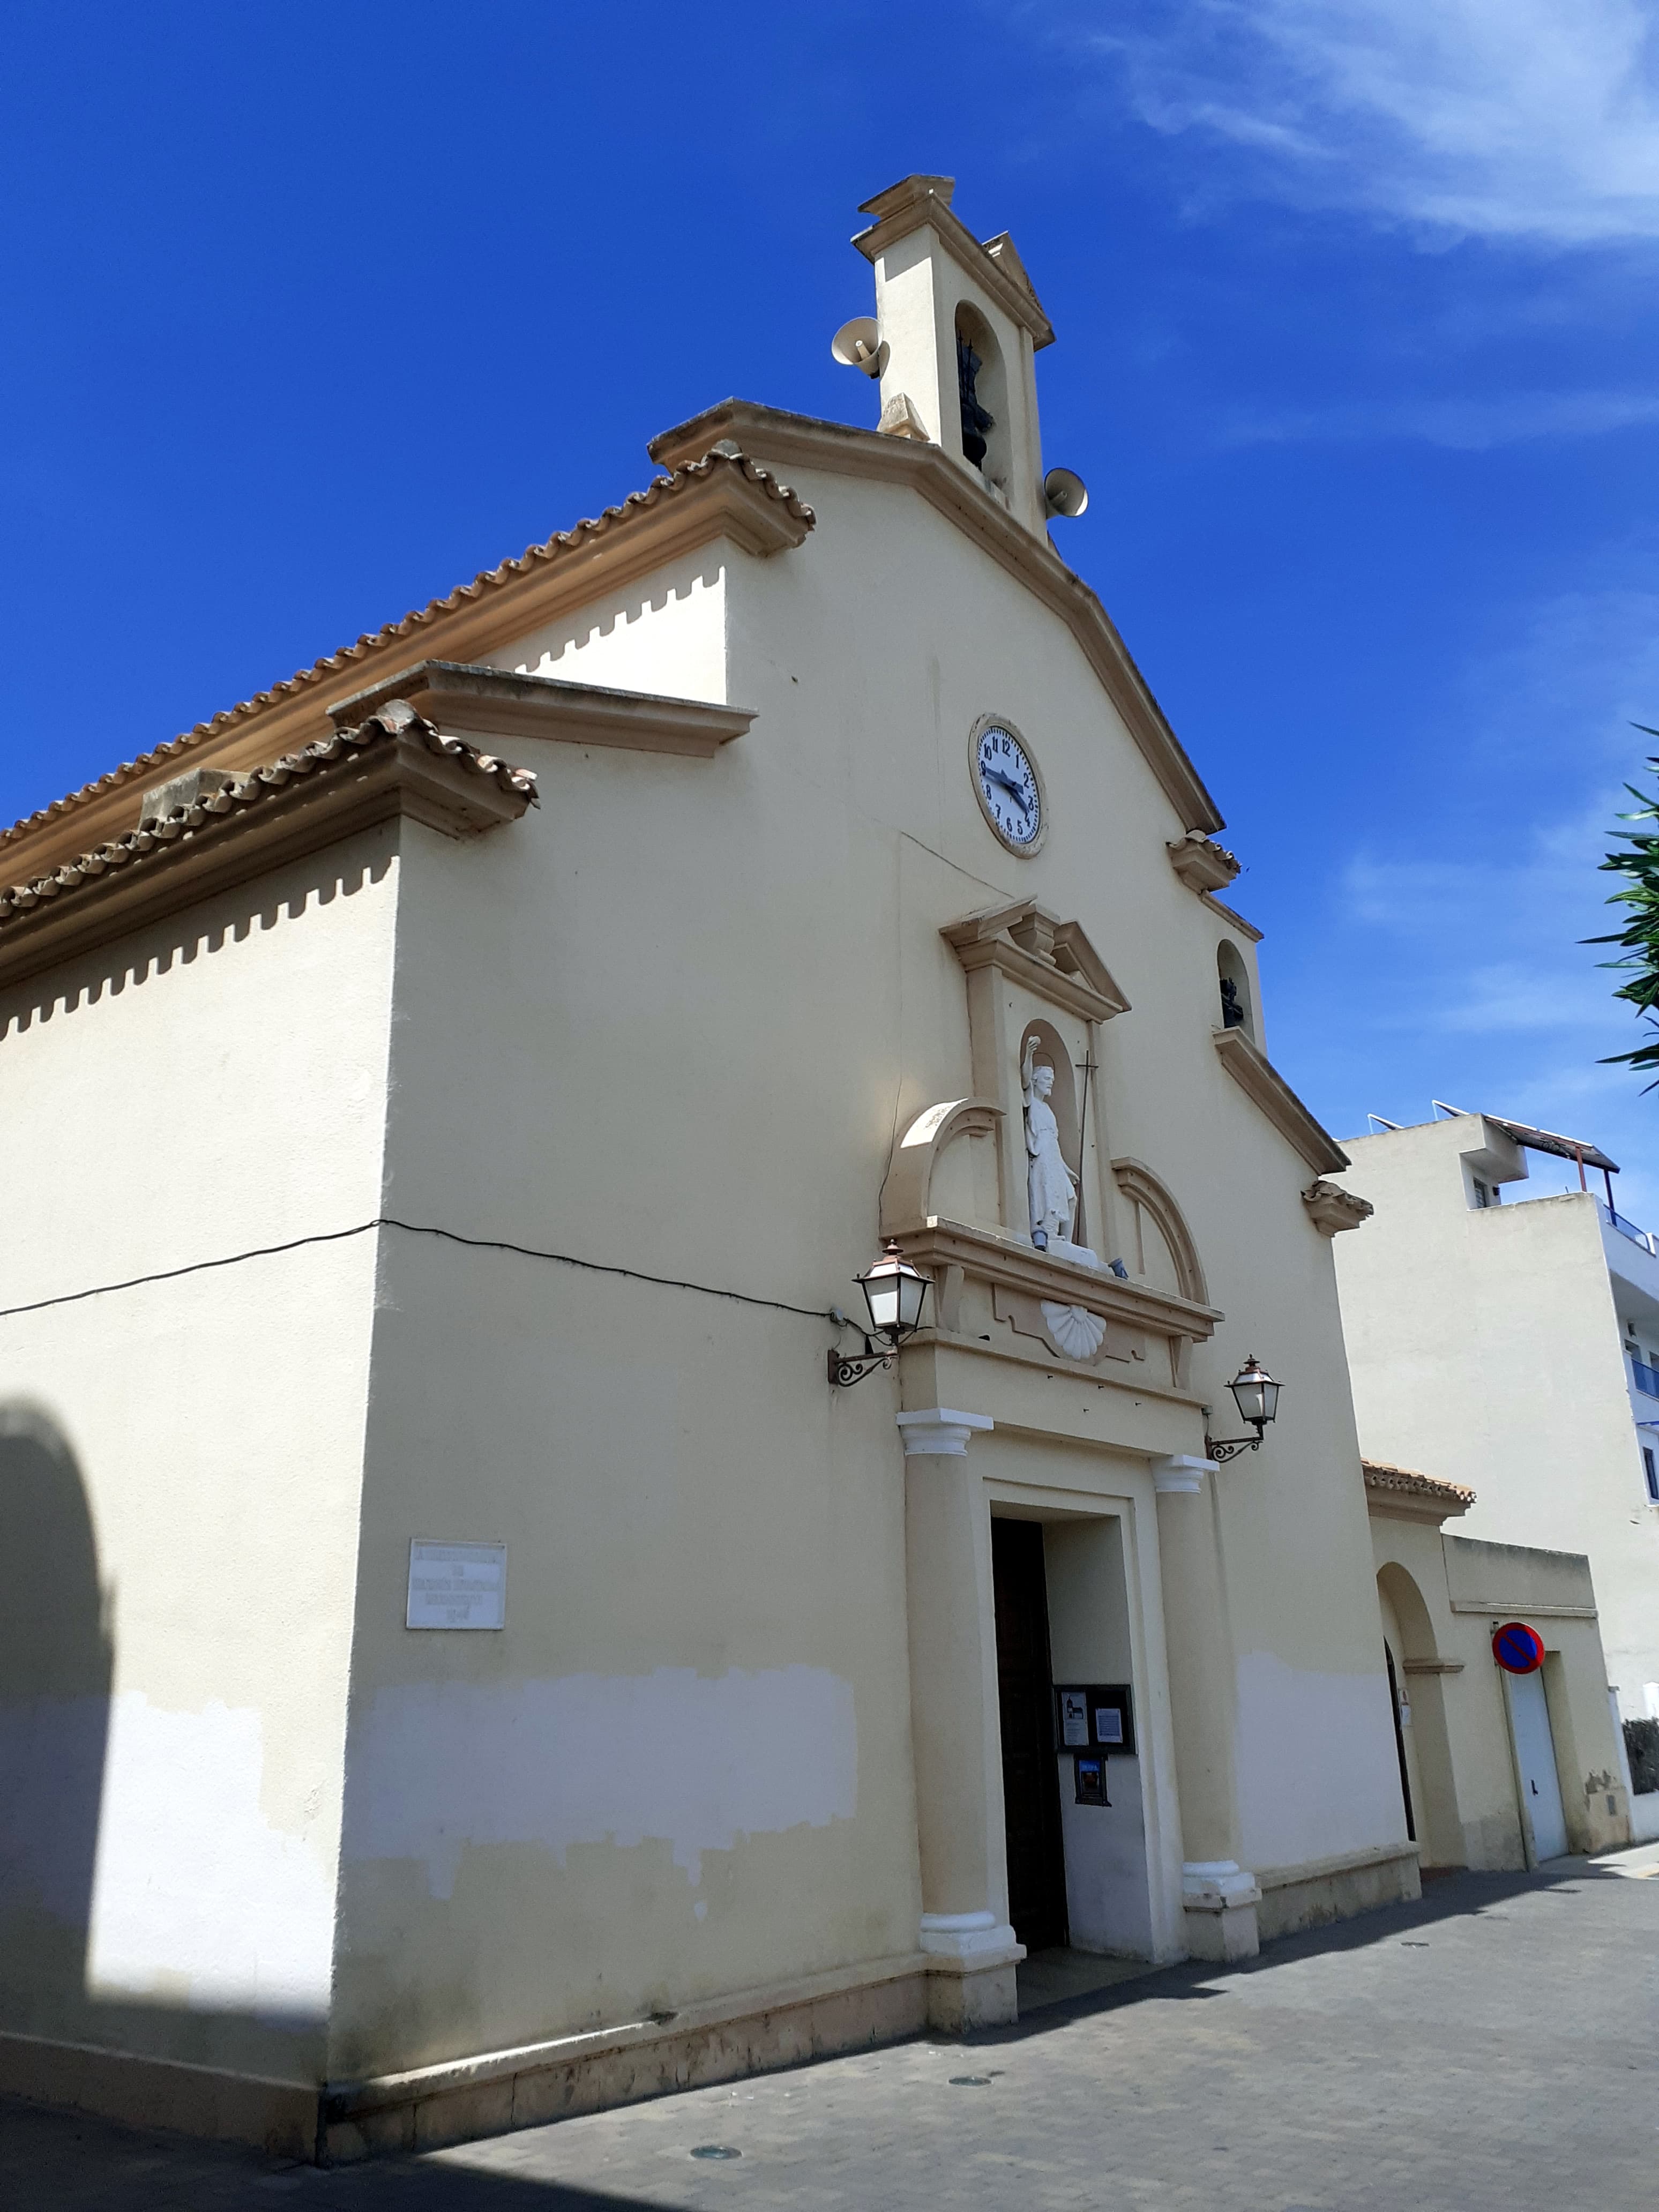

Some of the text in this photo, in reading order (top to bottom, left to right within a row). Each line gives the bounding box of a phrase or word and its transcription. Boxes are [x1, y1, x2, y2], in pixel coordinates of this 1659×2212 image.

[984, 744, 992, 760] 10
[992, 736, 999, 753] 11
[1002, 738, 1011, 757] 12
[981, 760, 986, 776] 9
[1015, 754, 1019, 769] 1
[1023, 773, 1029, 788] 2
[987, 784, 991, 800] 8
[996, 804, 1001, 819] 7
[1028, 796, 1034, 811] 3
[1007, 817, 1013, 832] 6
[1017, 819, 1022, 835] 5
